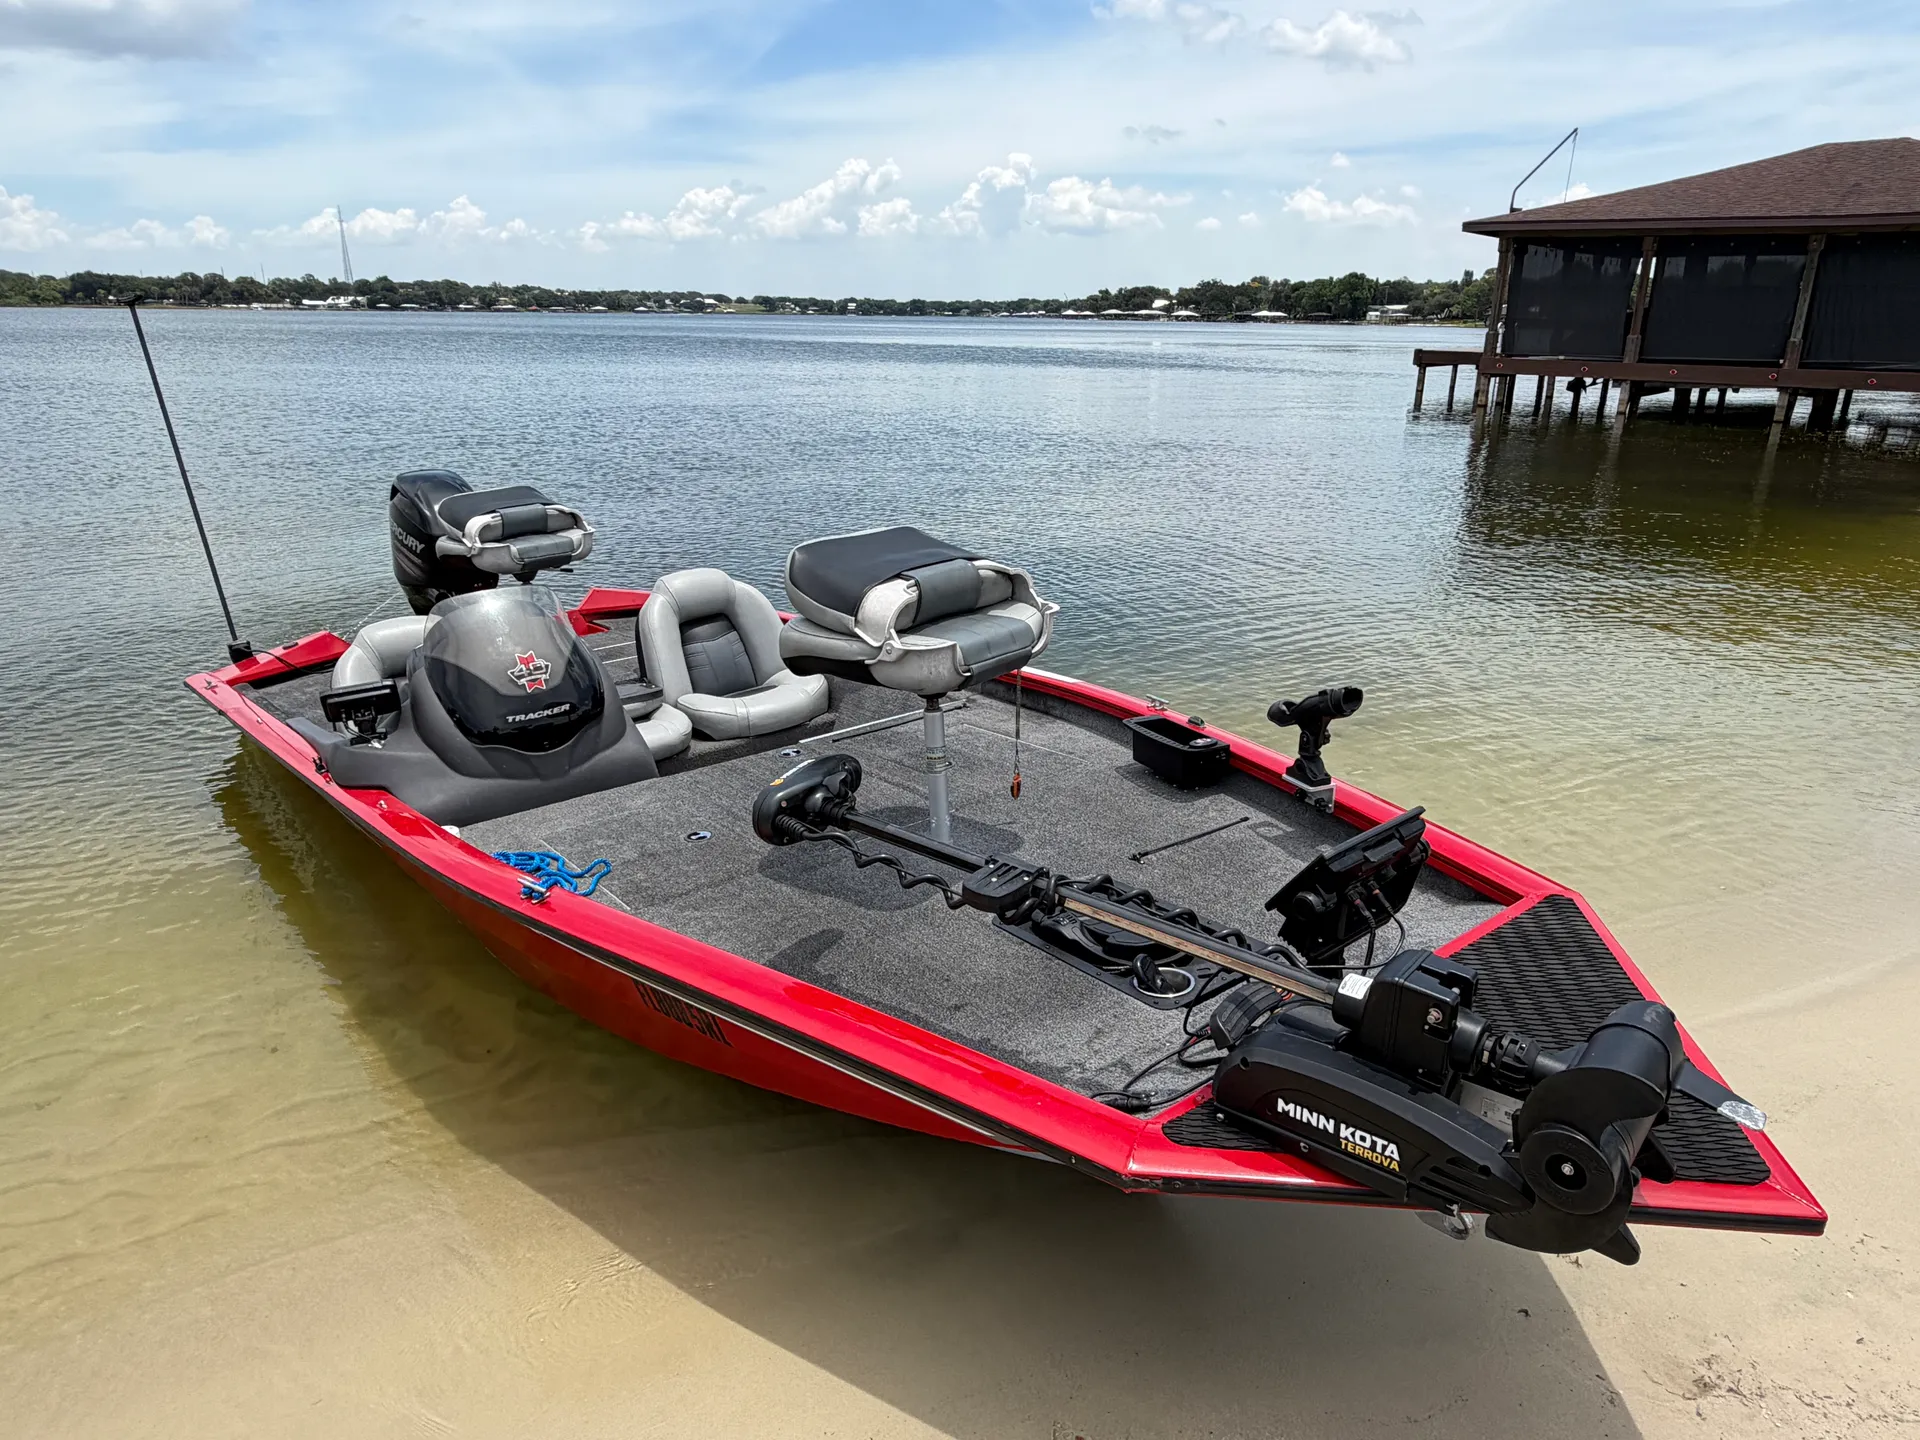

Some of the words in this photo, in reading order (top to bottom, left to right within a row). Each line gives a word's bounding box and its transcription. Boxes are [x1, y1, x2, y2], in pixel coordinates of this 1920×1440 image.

[390, 519, 426, 554] RCURY
[506, 703, 570, 723] TRACKER
[1276, 1097, 1335, 1134] MINN
[1339, 1122, 1400, 1161] KOTA
[1339, 1138, 1400, 1172] TERROVA
